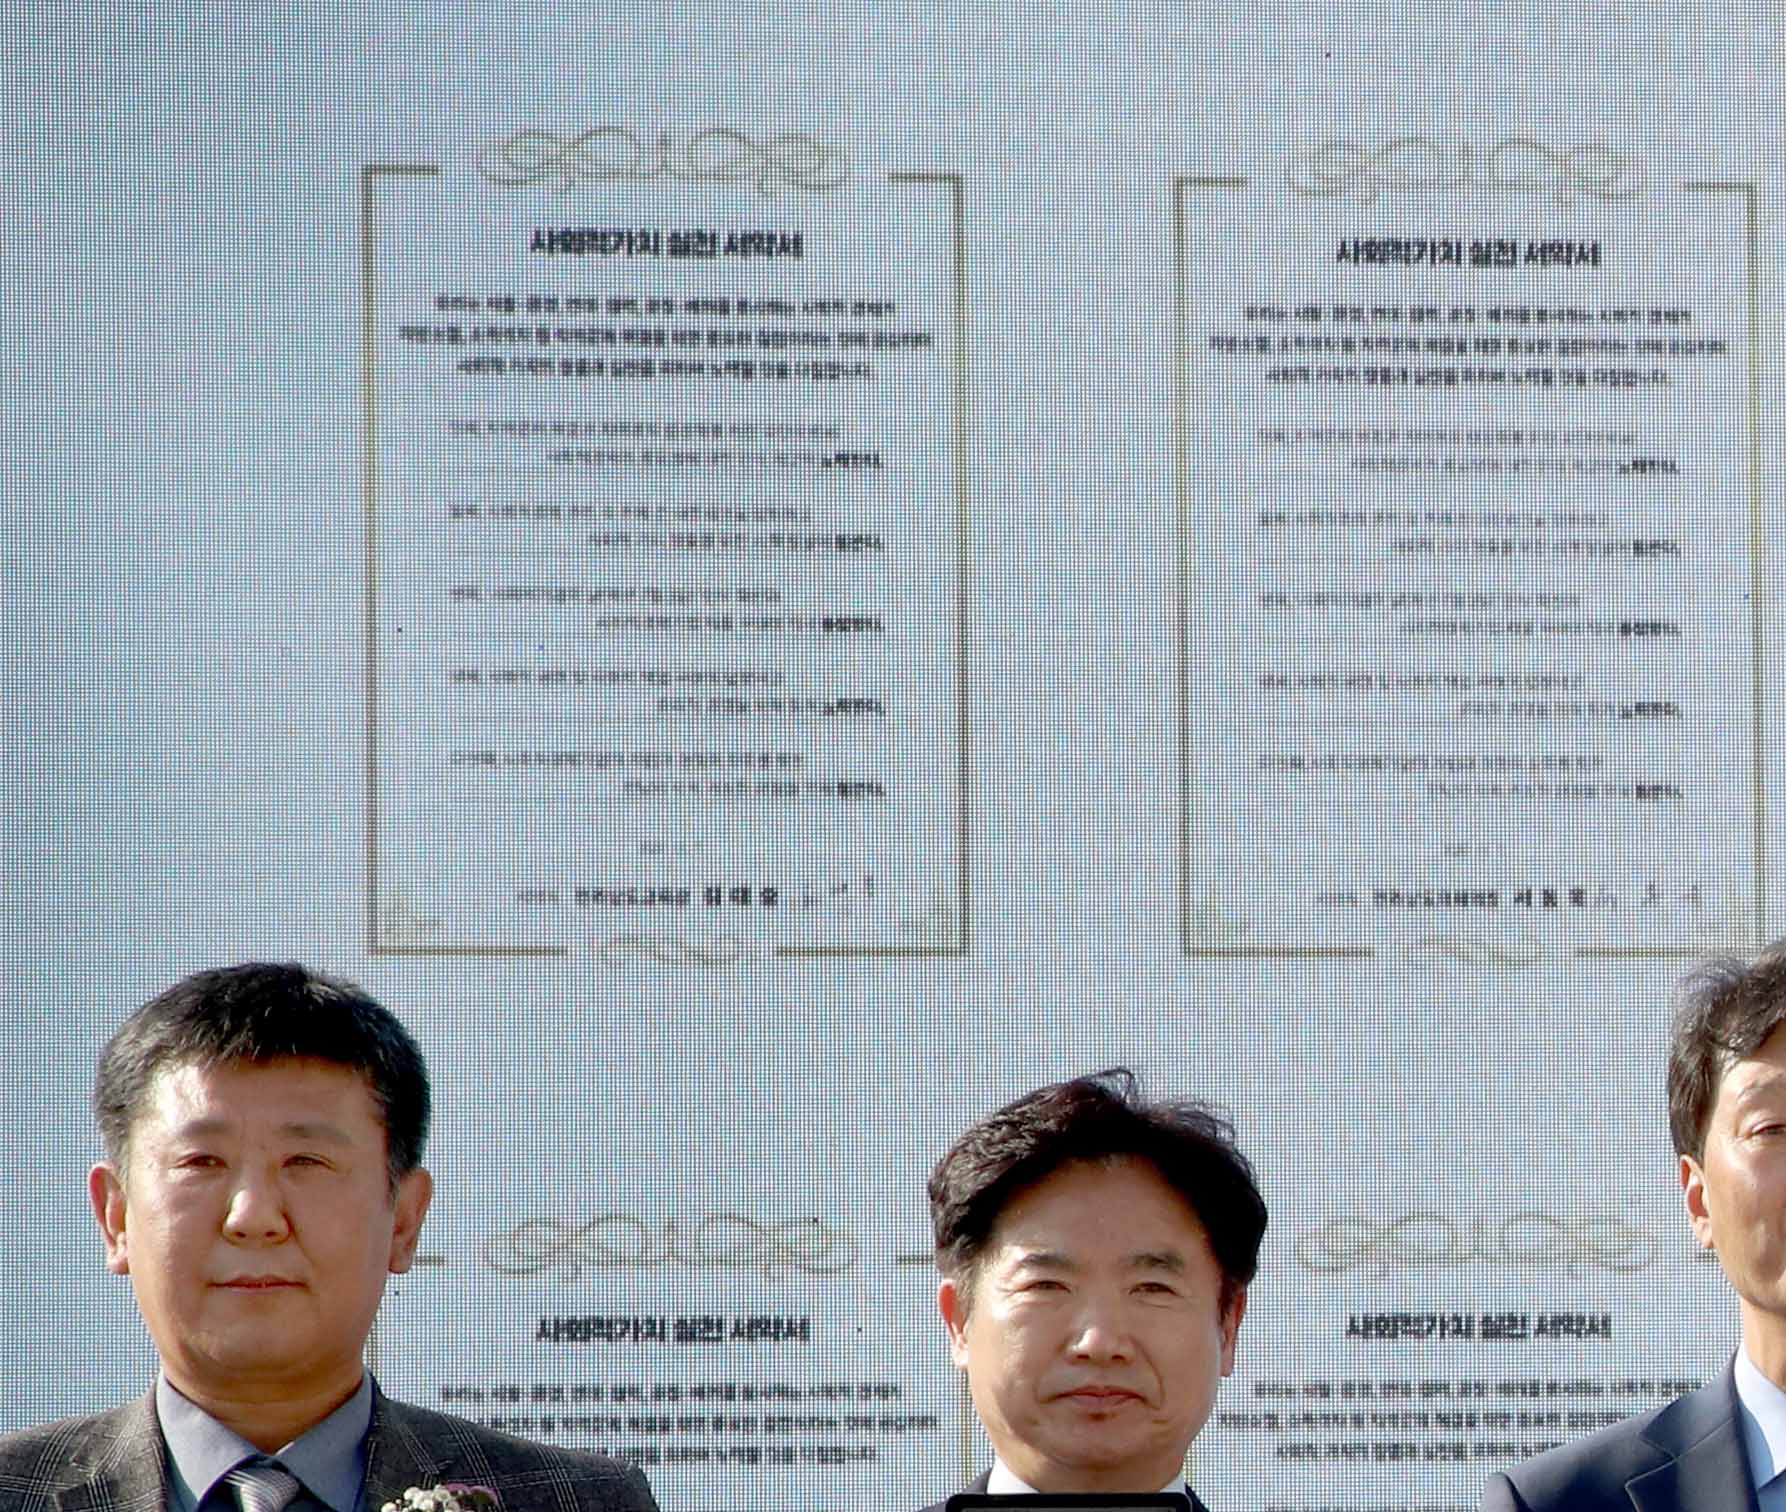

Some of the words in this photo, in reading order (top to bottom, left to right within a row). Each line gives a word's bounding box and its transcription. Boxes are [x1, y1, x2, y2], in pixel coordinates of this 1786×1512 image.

[529, 227, 662, 255] 사회적가치
[670, 229, 718, 258] 실천
[724, 231, 802, 259] 서약서
[1335, 237, 1464, 265] 사회적가치
[1471, 238, 1518, 267] 실천
[1524, 240, 1600, 268] 서약서
[536, 1315, 666, 1344] 사회적가치
[673, 1315, 724, 1344] 실천
[730, 1315, 808, 1344] 서약서
[1346, 1311, 1473, 1340] 사회적가치
[1480, 1311, 1527, 1340] 실천
[1534, 1311, 1611, 1340] 서약서
